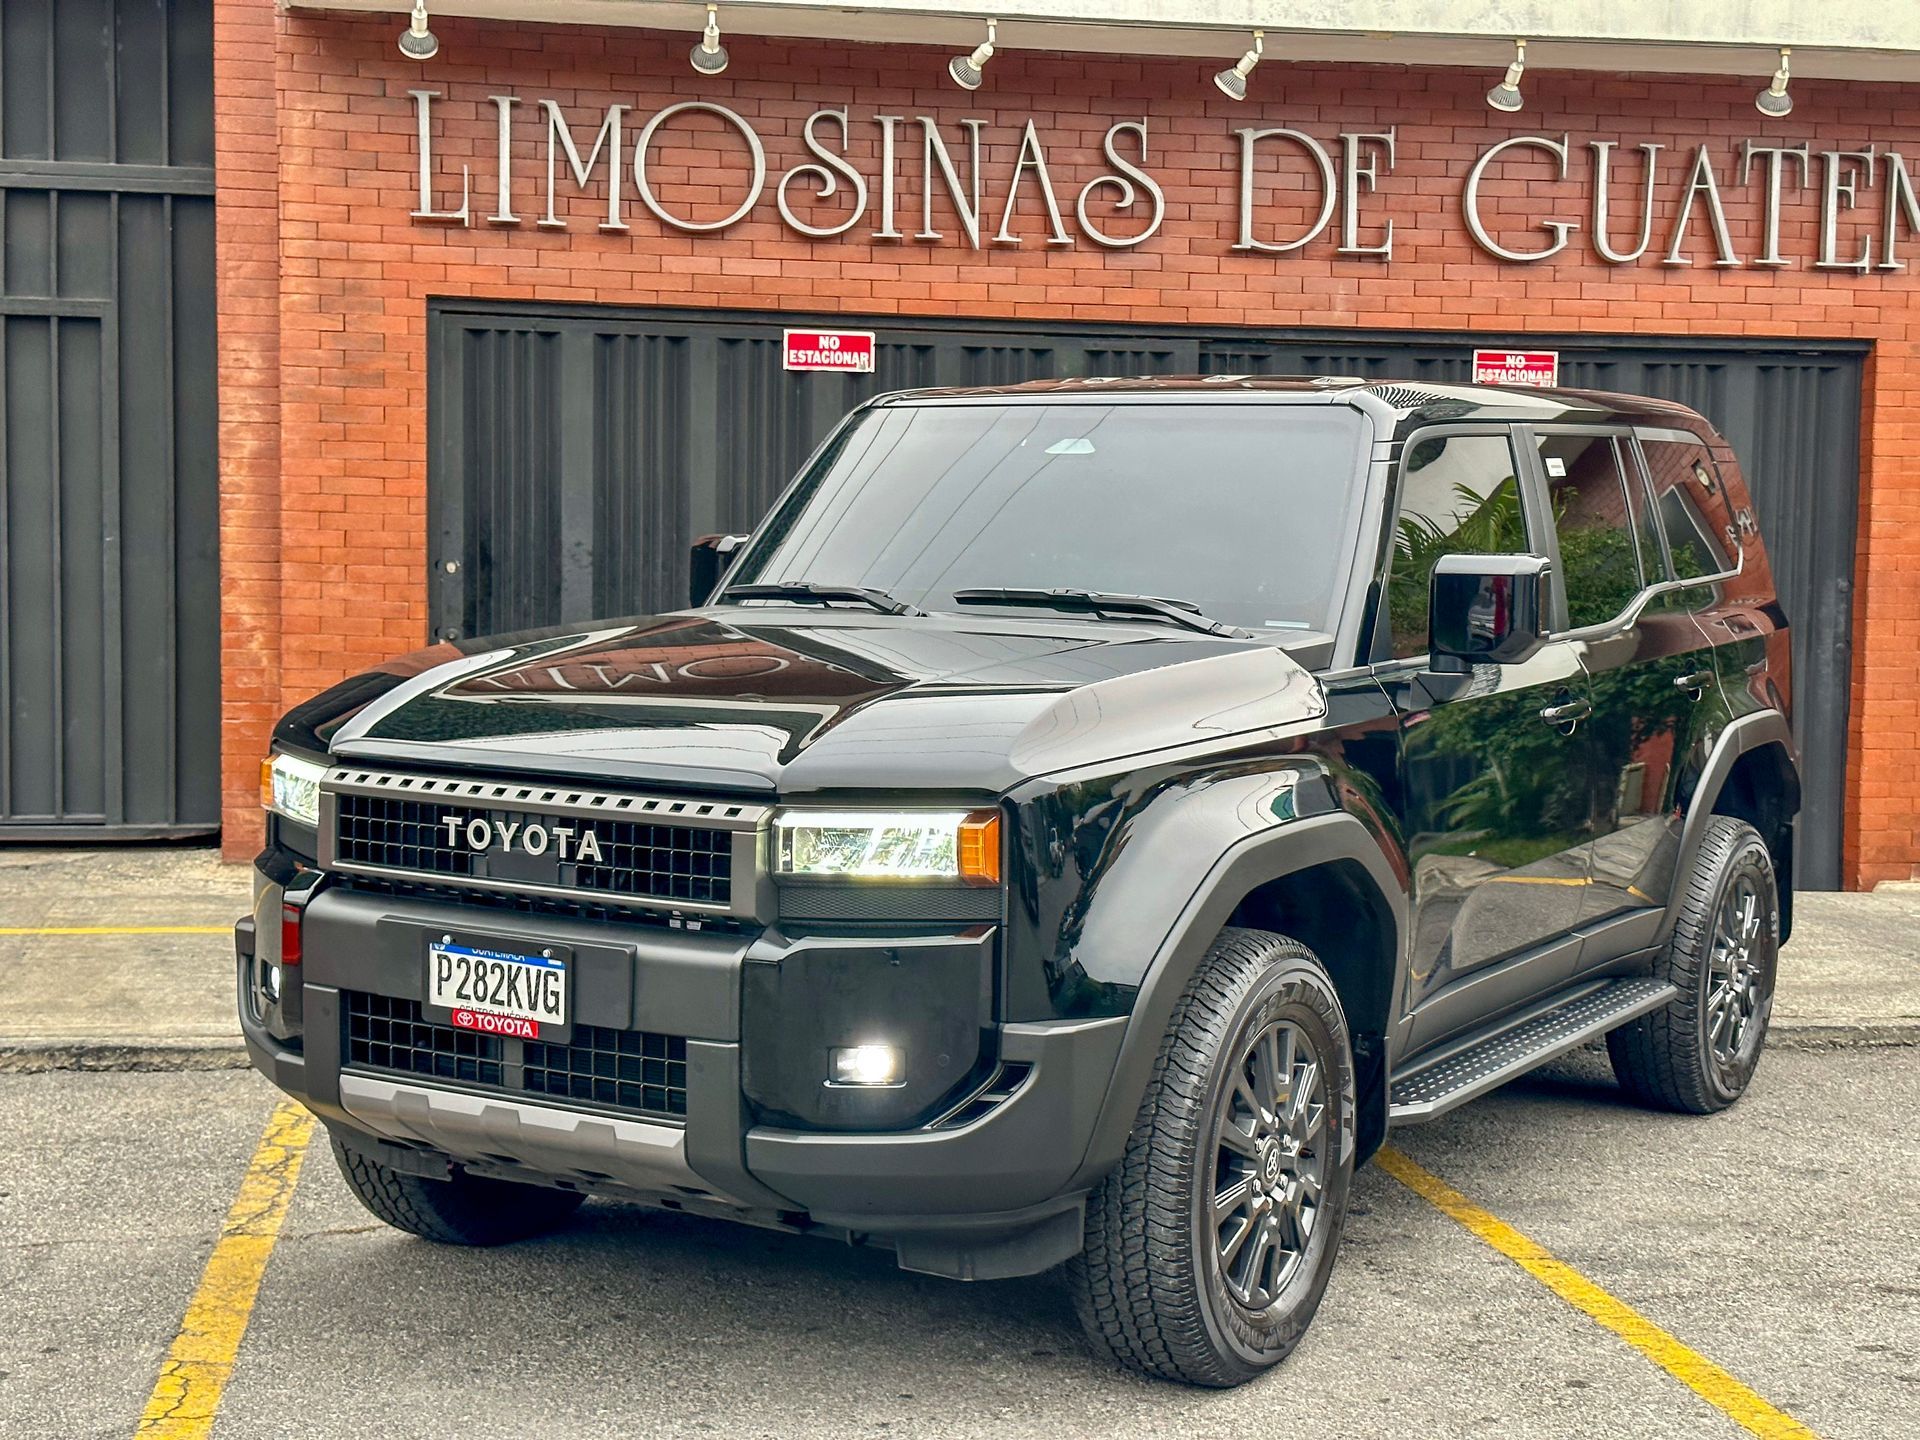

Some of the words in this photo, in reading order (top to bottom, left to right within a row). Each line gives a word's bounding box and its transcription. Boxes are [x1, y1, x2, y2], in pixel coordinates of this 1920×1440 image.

[408, 89, 1165, 250] LIMOSINAS
[1231, 125, 1396, 262] DE
[818, 335, 840, 349] NO
[788, 349, 870, 366] ESTACIONAR
[1505, 354, 1526, 369] NO
[442, 815, 603, 862] TOYOTA
[475, 1014, 533, 1037] TOYOTA
